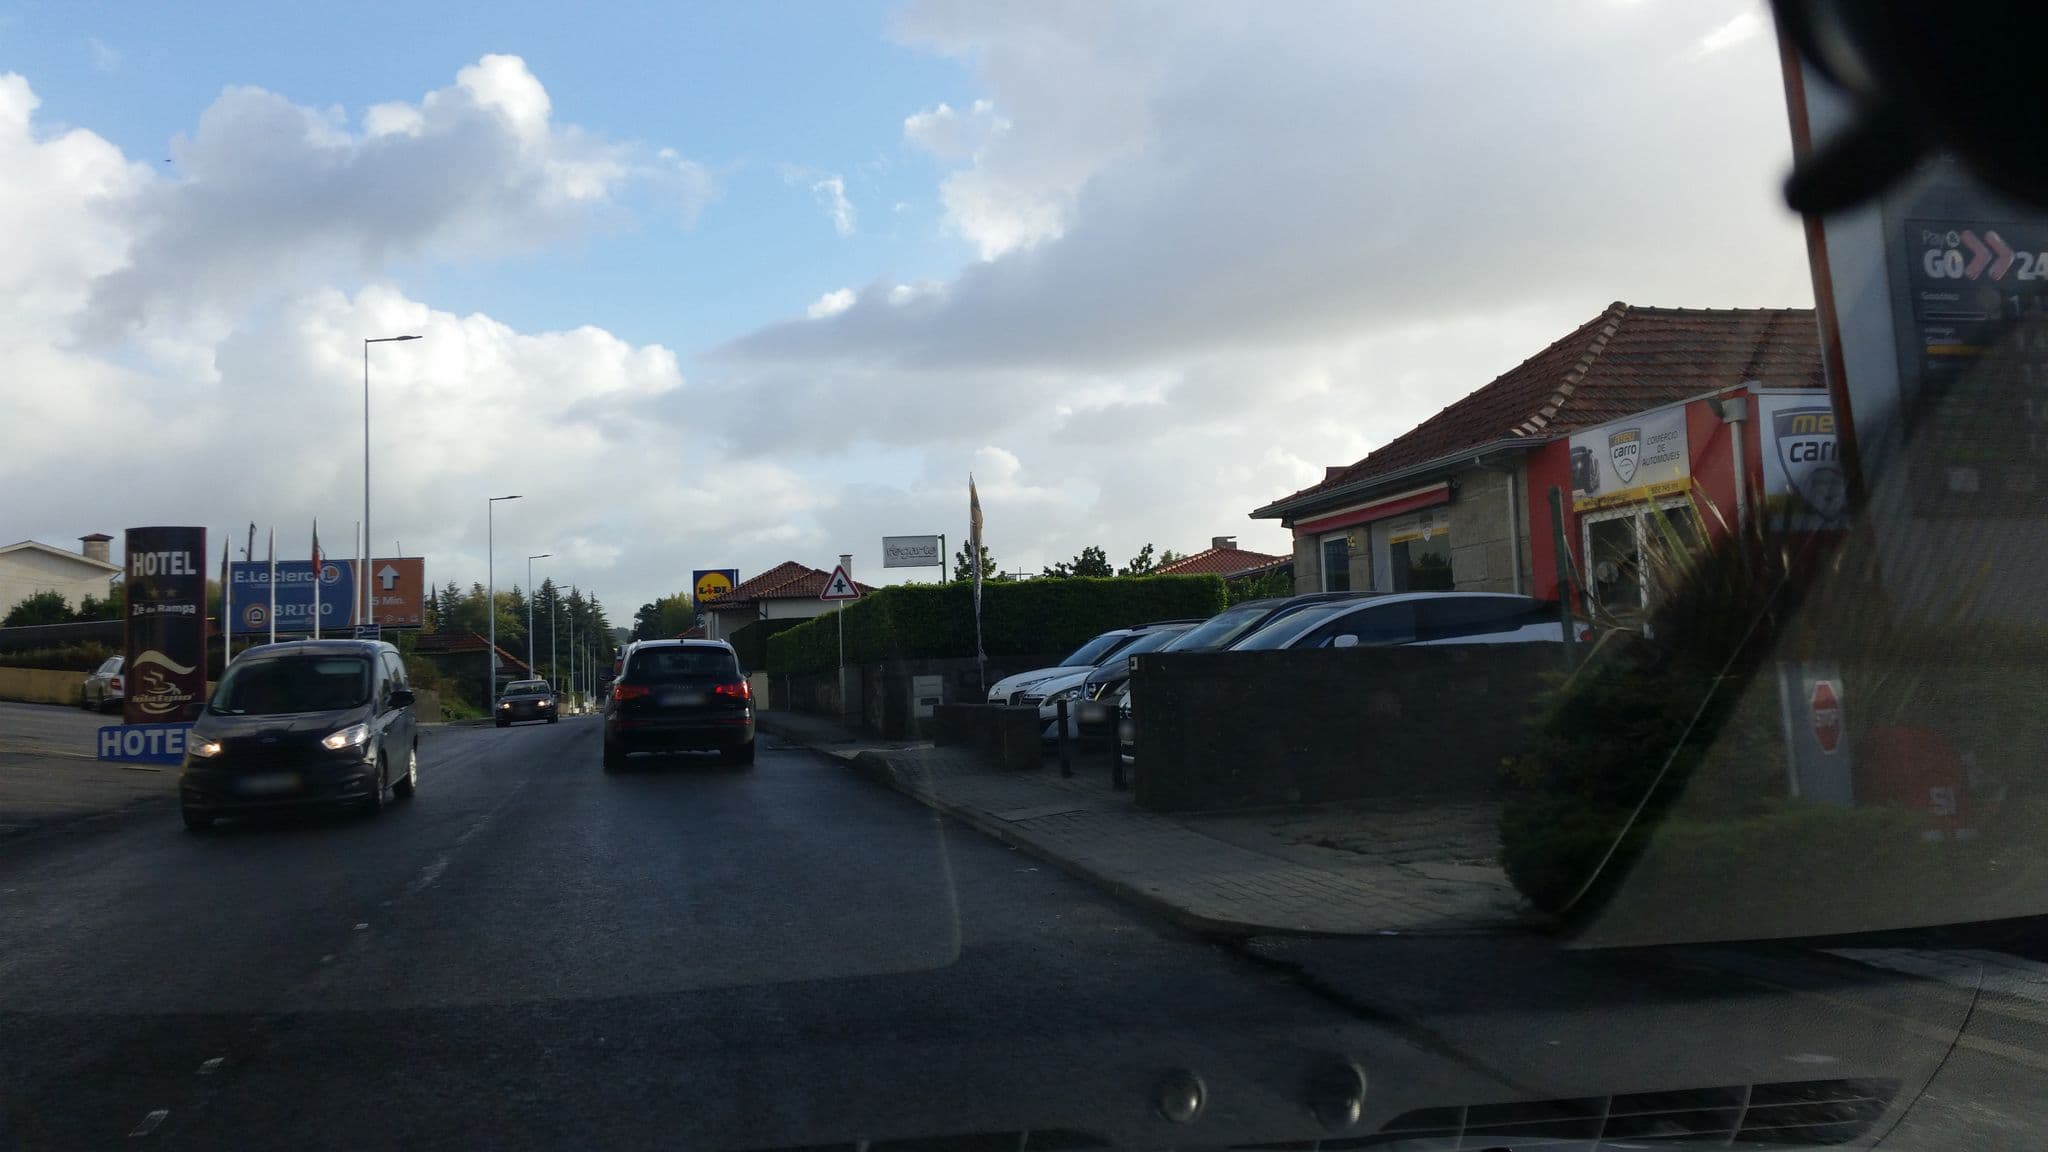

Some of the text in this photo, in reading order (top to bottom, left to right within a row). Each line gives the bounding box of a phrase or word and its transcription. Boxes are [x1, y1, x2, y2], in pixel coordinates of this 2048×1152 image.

[1923, 249, 1965, 279] GO
[1791, 414, 1833, 434] me
[1613, 444, 1637, 459] carro
[1656, 443, 1666, 454] DE
[132, 551, 196, 577] HOTEL
[157, 604, 196, 615] Rampa
[101, 728, 192, 757] HOTE
